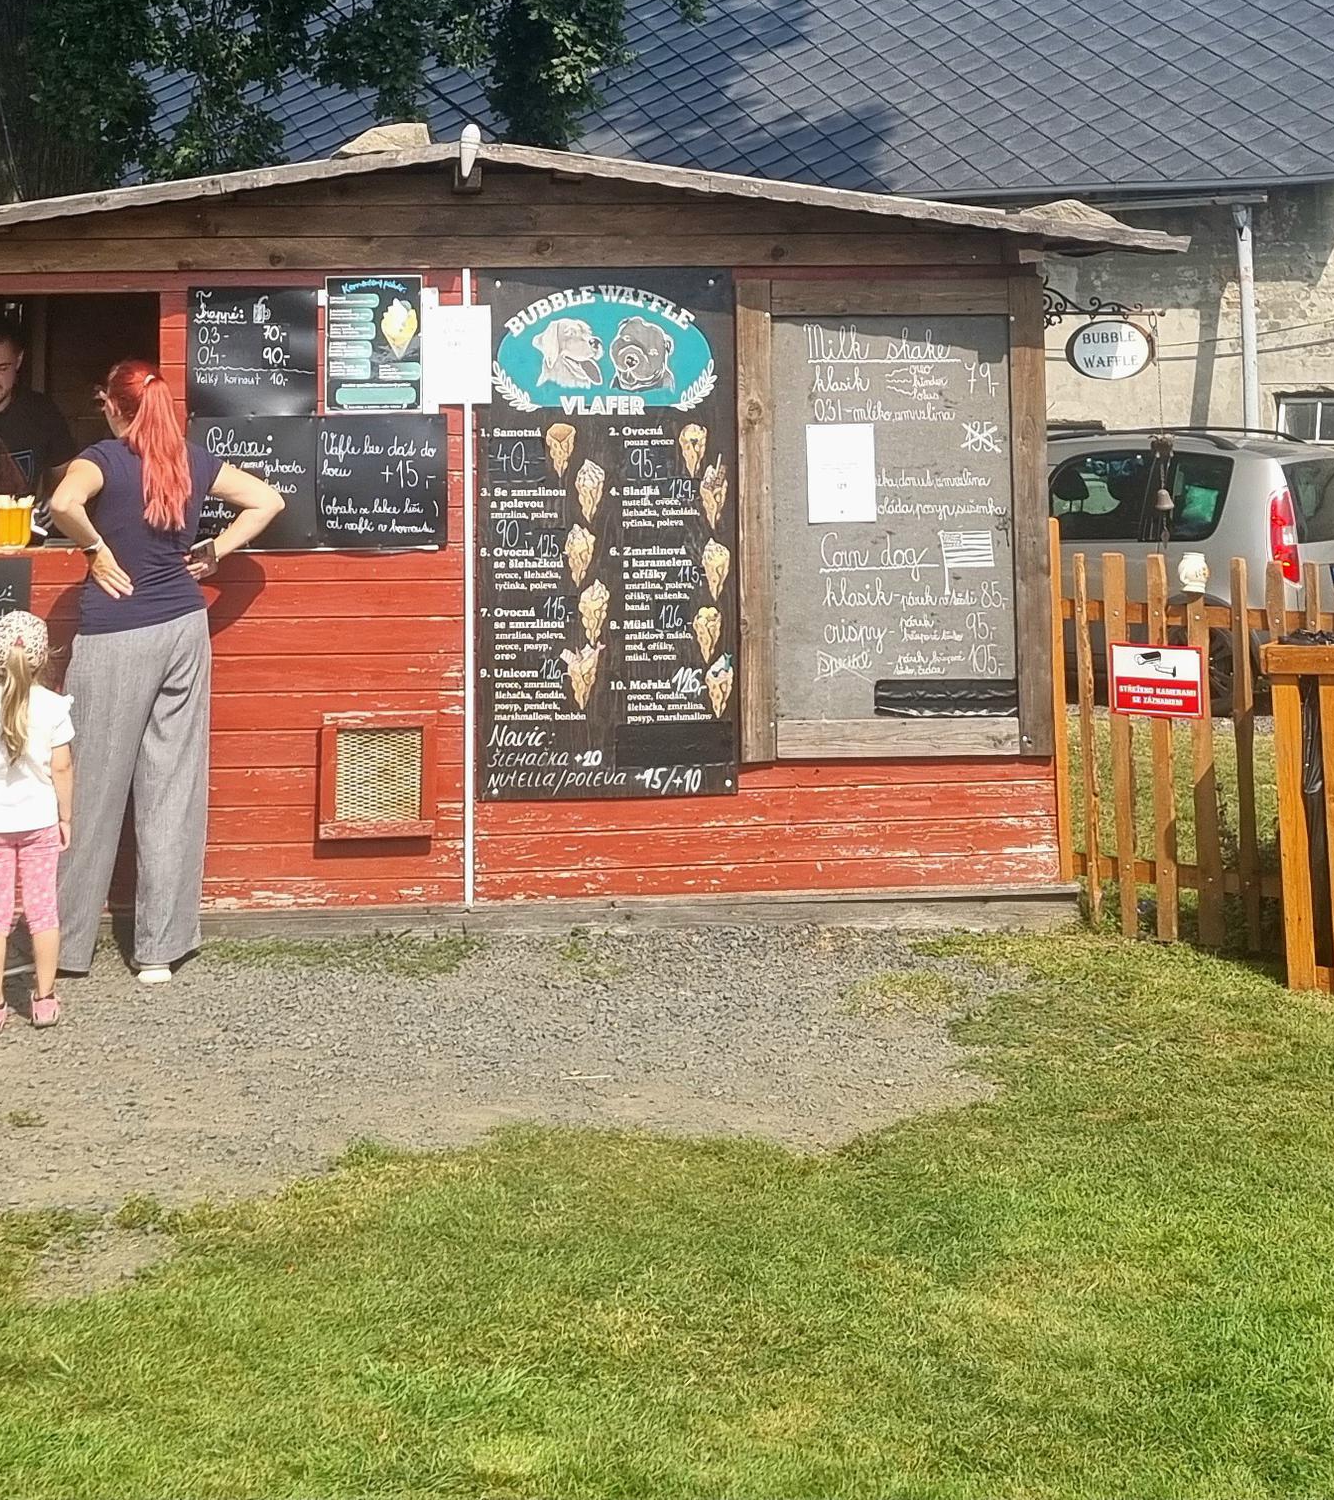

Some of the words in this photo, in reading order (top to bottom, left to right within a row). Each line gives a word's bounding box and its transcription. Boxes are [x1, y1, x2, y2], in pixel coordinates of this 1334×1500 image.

[504, 285, 596, 337] BUBBLE
[598, 285, 696, 332] WAFFLE
[803, 323, 870, 360] Milk
[886, 327, 951, 360] shake
[1082, 330, 1136, 344] BUBBLE
[1083, 354, 1139, 368] WAFFLE
[812, 365, 870, 393] klasik
[560, 395, 646, 416] VLAFER
[480, 428, 490, 437] 1.
[493, 427, 542, 437] Samotná
[608, 427, 619, 436] 2.
[622, 425, 663, 436] Ovocná
[321, 431, 361, 462] Vafle
[420, 440, 437, 457] do
[624, 439, 649, 448] pouze
[480, 488, 491, 497] 3.
[494, 487, 508, 497] Se
[511, 487, 566, 497] zmrzlinou
[609, 487, 620, 496] 4.
[623, 485, 660, 496] Sladká
[500, 499, 544, 511] polevou
[530, 511, 558, 521] poleva
[657, 518, 684, 528] poleva
[480, 548, 491, 557] 5.
[493, 547, 535, 557] Ovocná
[609, 547, 620, 556] 6.
[623, 545, 686, 556] Zmrzlinová
[821, 532, 869, 567] Corn
[880, 534, 928, 581] dog
[493, 561, 506, 569] se
[508, 559, 564, 569] šlehačkou
[632, 558, 692, 567] karamelem
[632, 569, 667, 581] oříšky
[529, 582, 558, 592] poleva
[625, 602, 650, 611] banán
[480, 608, 491, 617] 7.
[494, 607, 536, 617] Ovocná
[494, 621, 506, 629] se
[509, 619, 565, 629] zmrzlinou
[609, 620, 620, 629] 8.
[623, 619, 654, 629] Müsli
[480, 669, 491, 678] 9.
[494, 668, 539, 678] Unicorn
[610, 681, 627, 690] 10.
[630, 680, 671, 690] Mořská
[555, 712, 586, 721] bonbón
[657, 712, 713, 722] marshmallow
